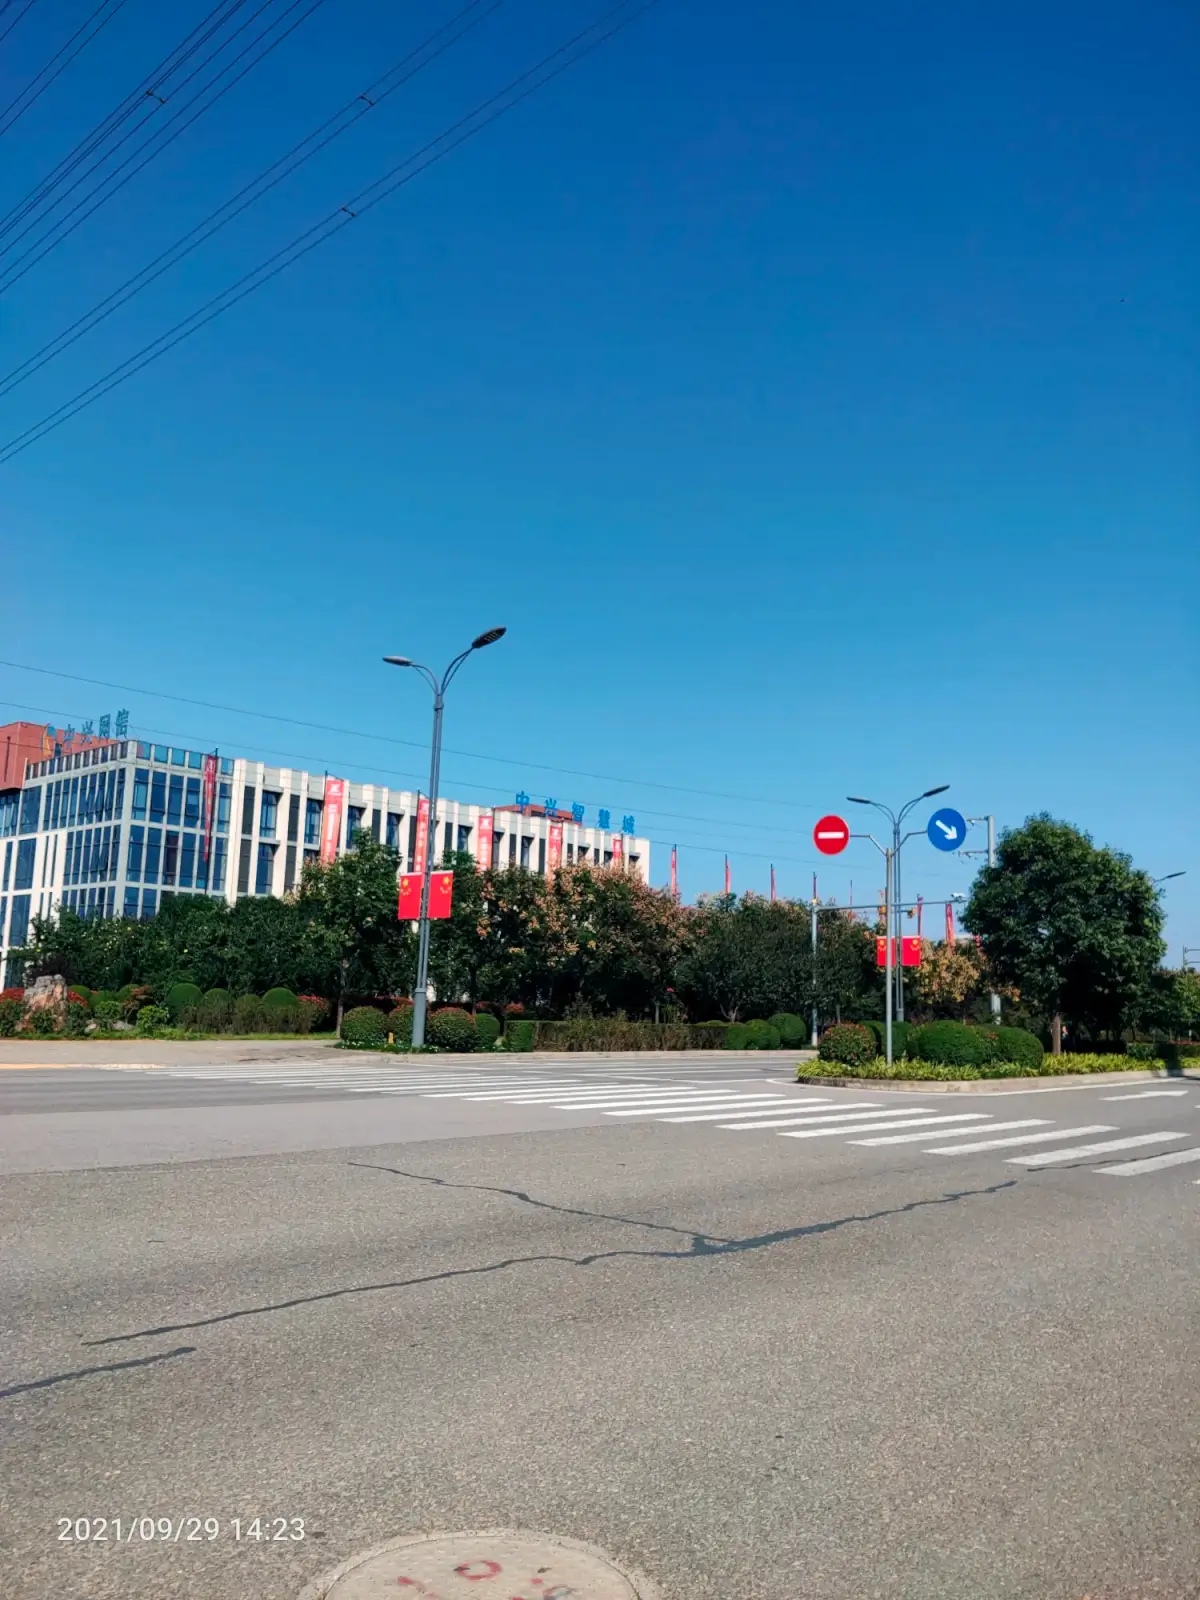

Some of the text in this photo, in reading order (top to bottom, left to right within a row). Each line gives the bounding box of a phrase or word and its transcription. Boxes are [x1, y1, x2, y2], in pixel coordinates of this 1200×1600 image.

[62, 708, 130, 749] 中兴网信
[516, 790, 635, 835] 中兴智慧城
